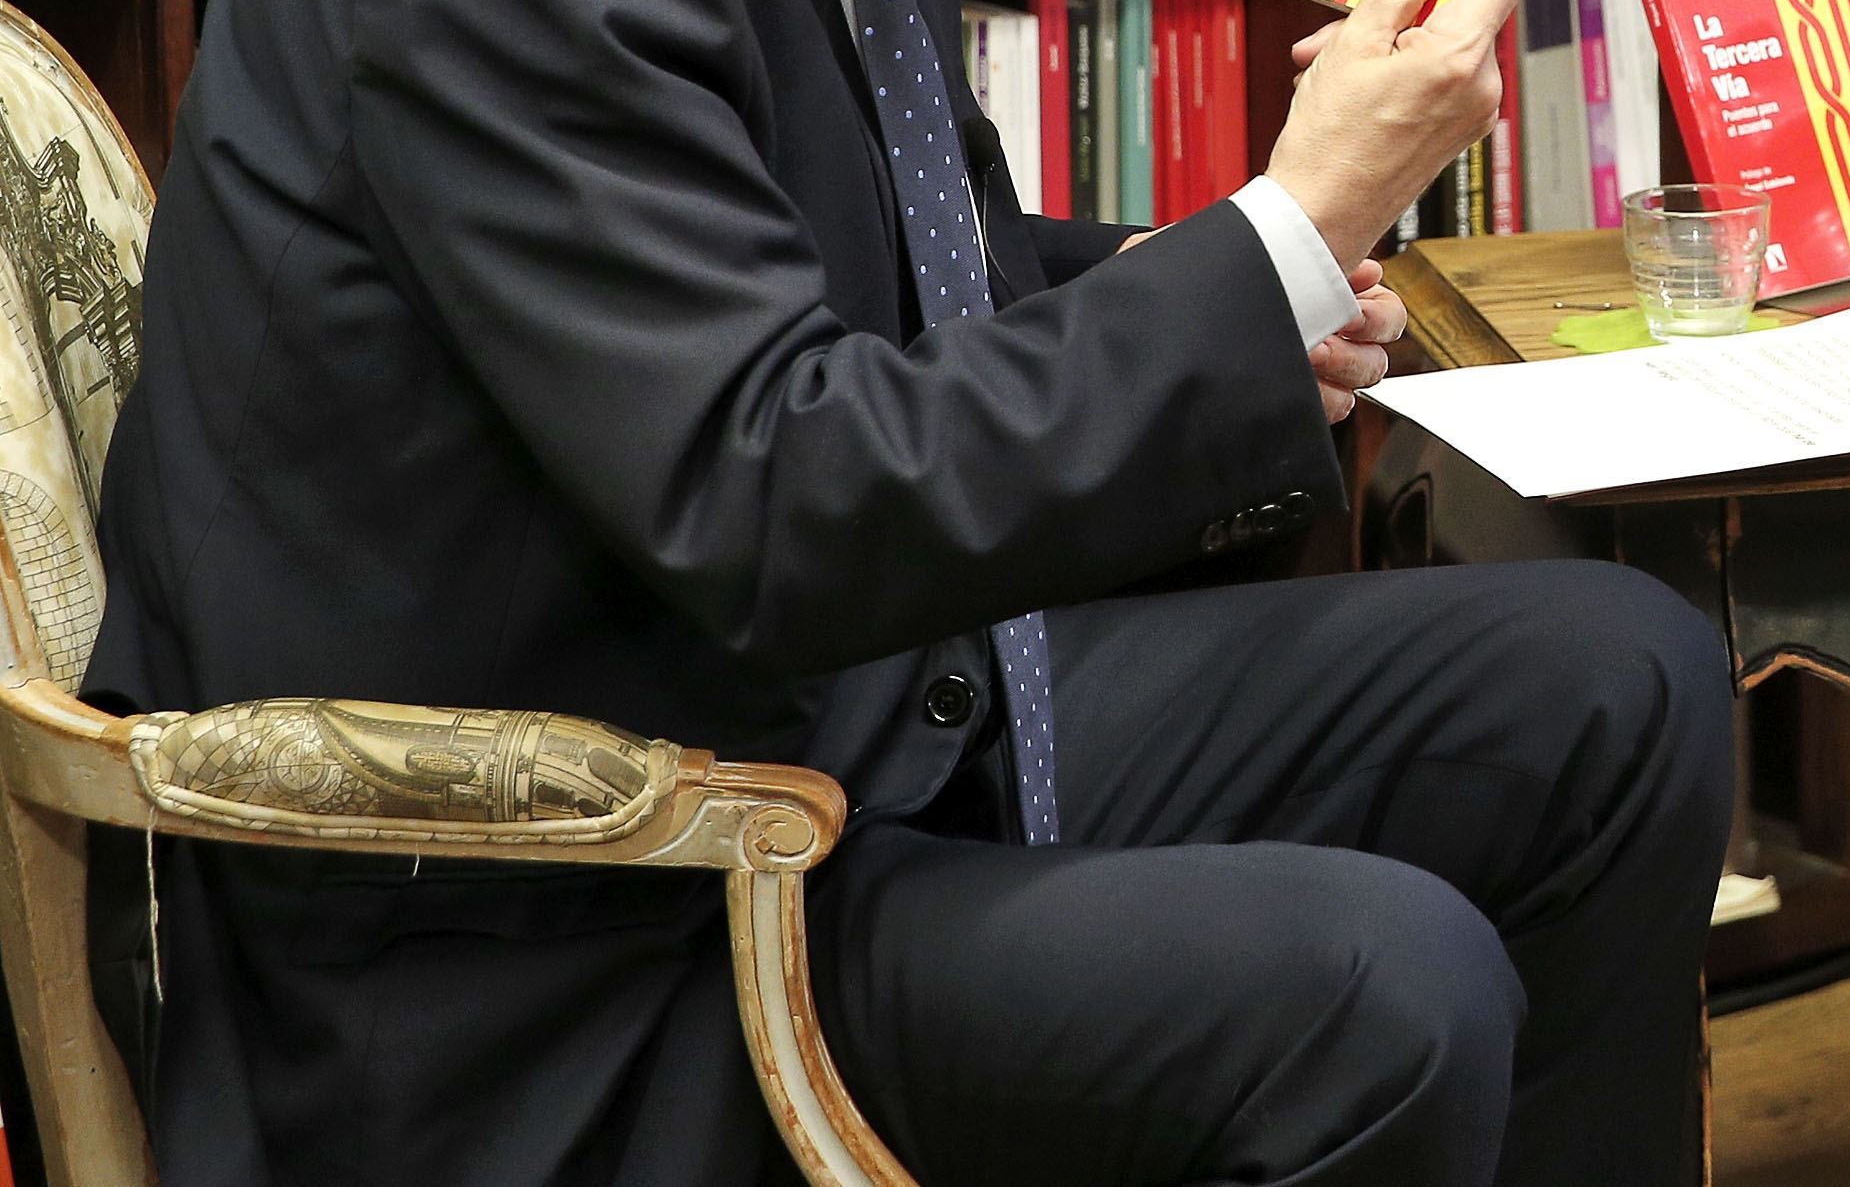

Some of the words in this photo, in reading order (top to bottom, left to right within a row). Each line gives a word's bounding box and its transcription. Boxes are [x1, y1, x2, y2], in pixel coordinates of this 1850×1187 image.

[1693, 13, 1725, 41] La
[1701, 36, 1783, 71] Tercera
[1711, 72, 1751, 102] Vía
